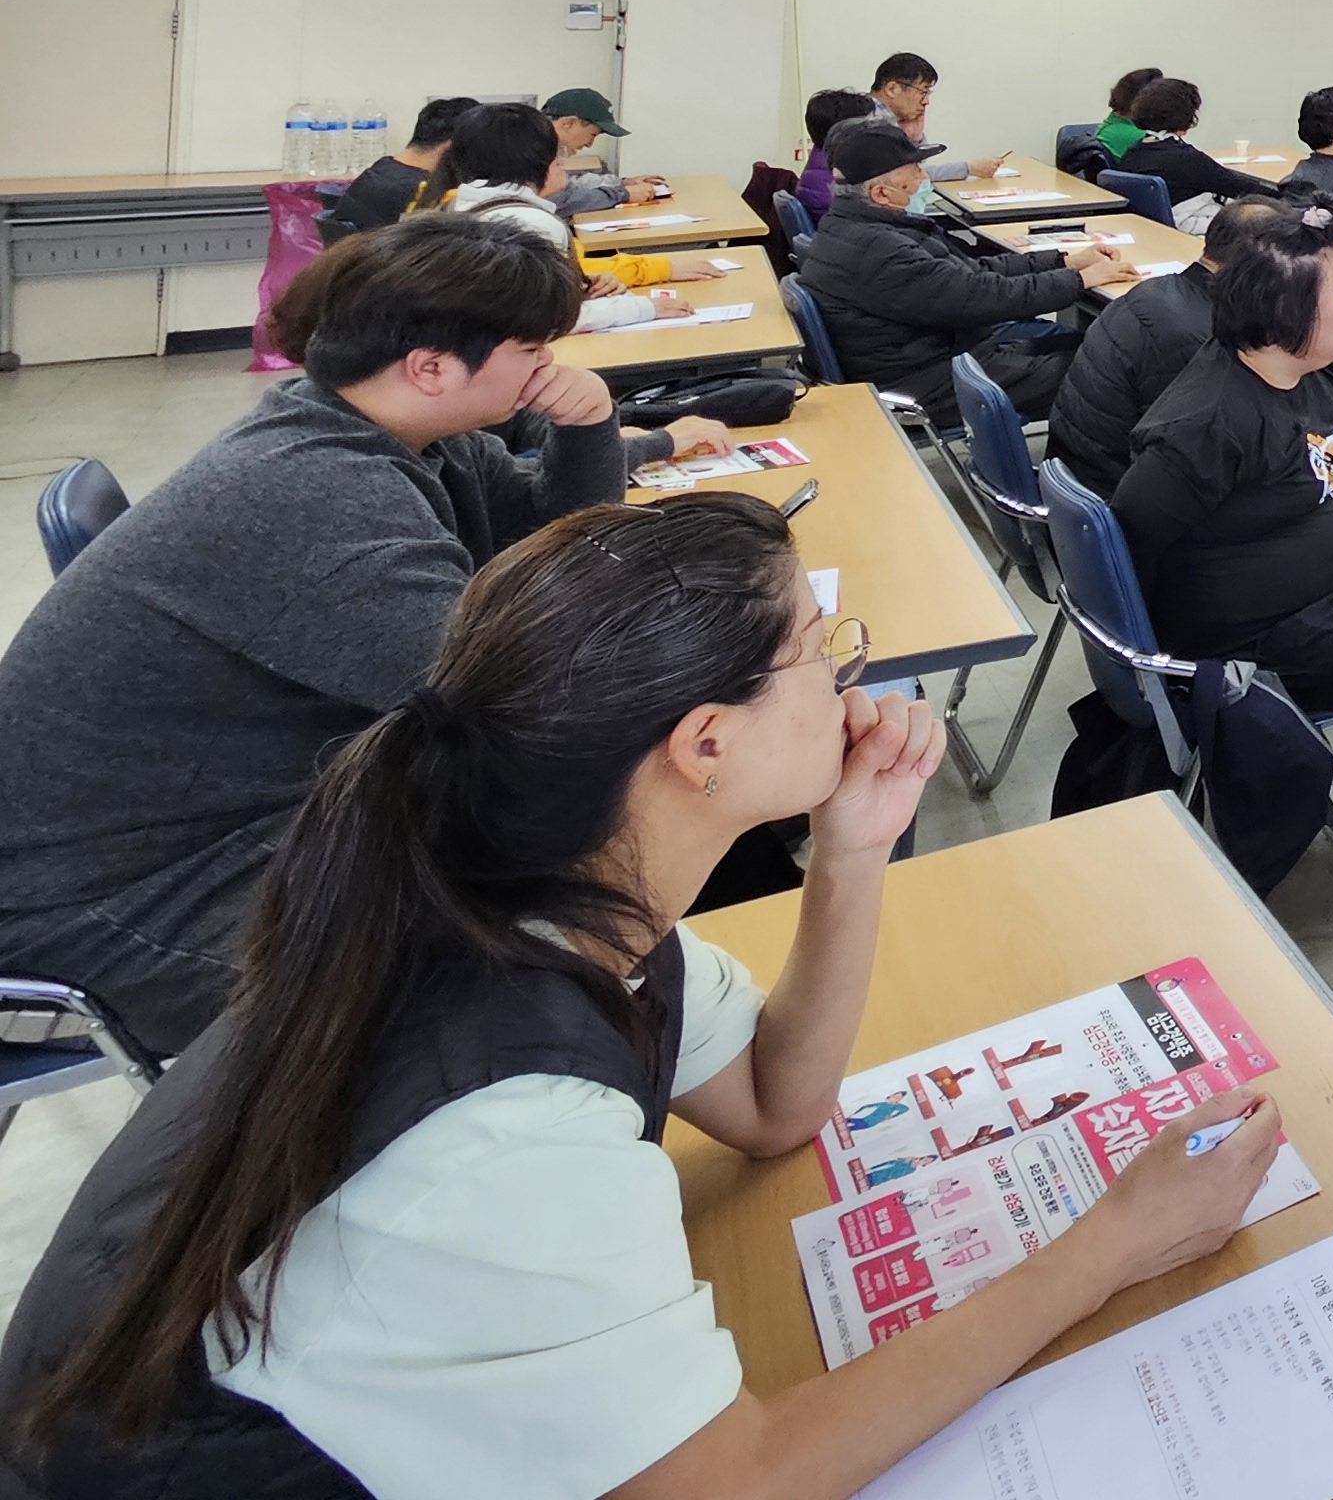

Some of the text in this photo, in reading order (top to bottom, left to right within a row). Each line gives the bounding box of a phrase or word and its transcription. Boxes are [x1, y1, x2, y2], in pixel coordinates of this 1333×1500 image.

[1084, 1024, 1119, 1066] 심근경색증
[1147, 1010, 1192, 1060] 심근경색증
[1027, 1163, 1042, 1175] 우리
[987, 1156, 1014, 1189] 검사받기!
[1002, 1192, 1030, 1228] 상담하기!
[1032, 1174, 1047, 1188] 모두
[1038, 1187, 1053, 1200] 건강
[1307, 1273, 1331, 1299] 10월
[1295, 1329, 1313, 1348] 대한
